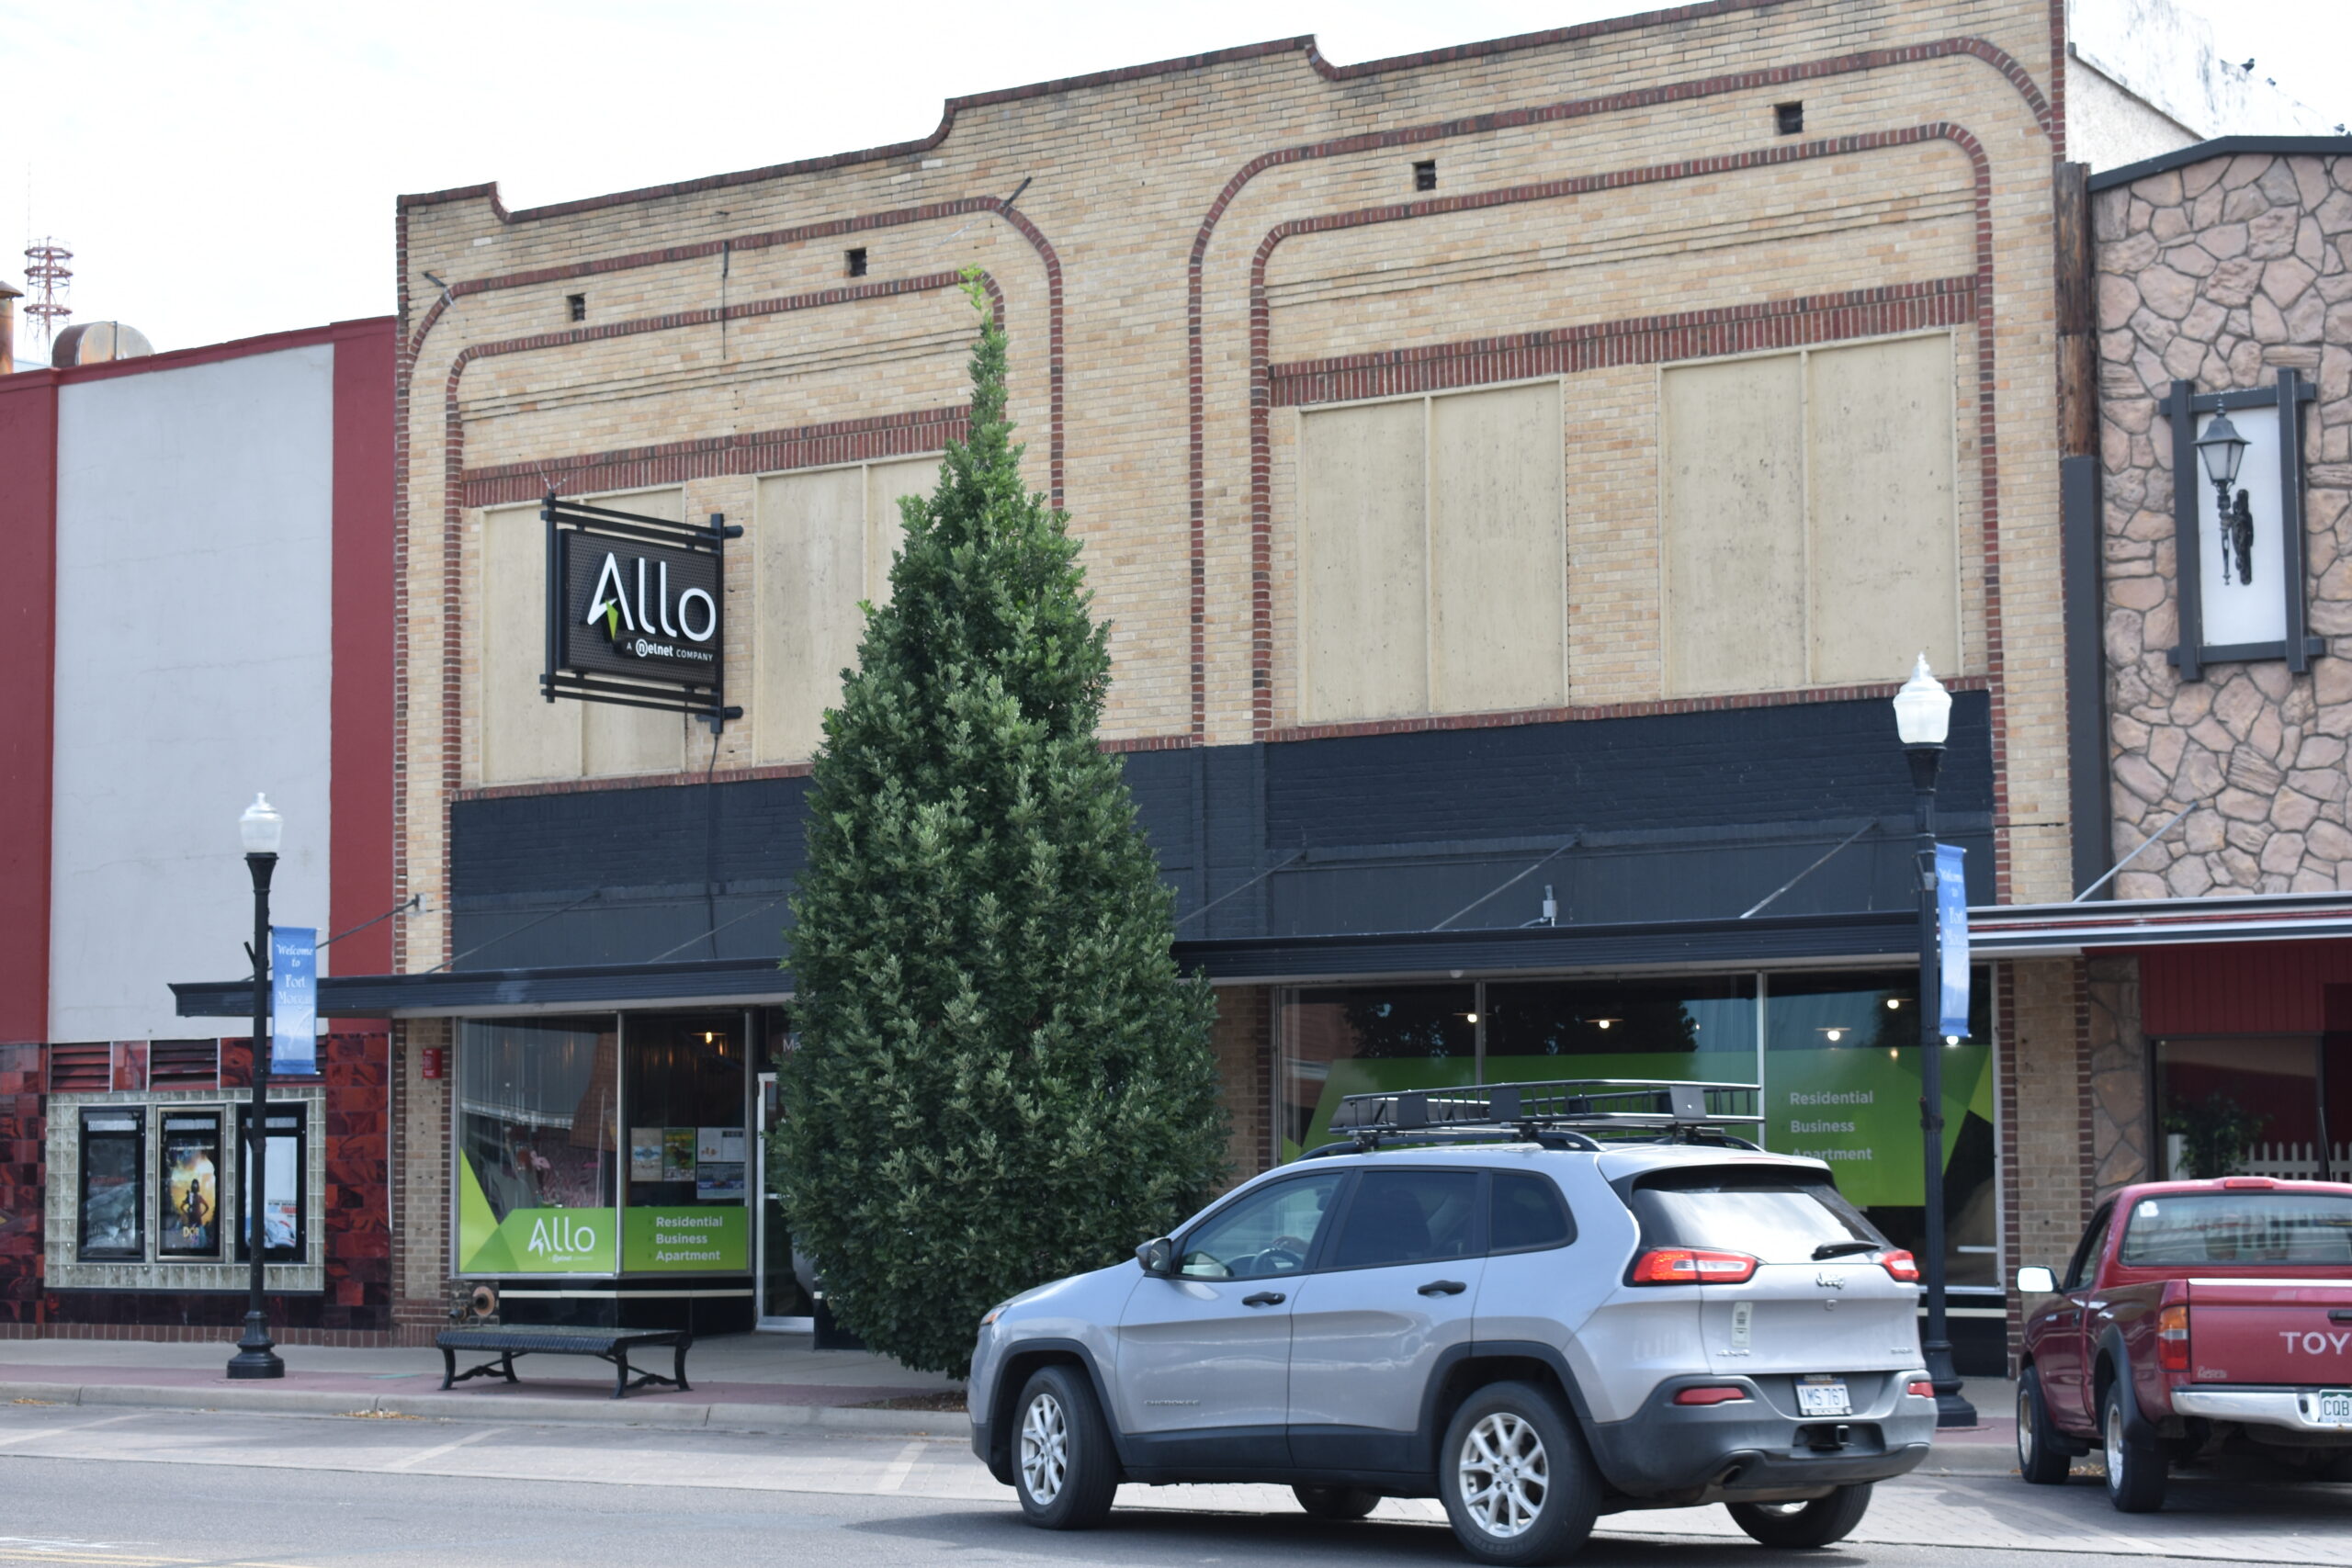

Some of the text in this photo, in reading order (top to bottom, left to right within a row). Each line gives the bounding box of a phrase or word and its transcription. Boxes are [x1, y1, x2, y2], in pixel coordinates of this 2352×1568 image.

[587, 552, 716, 641] Allo
[627, 638, 713, 661] A nelnet COMPANY
[277, 944, 313, 955] Welcome
[292, 958, 300, 967] to
[285, 974, 305, 987] Fort
[1790, 1090, 1874, 1105] Residential
[1791, 1119, 1855, 1133] Business
[656, 1215, 723, 1227] Residential
[527, 1216, 595, 1257] Allo
[656, 1233, 708, 1244] Business
[656, 1250, 721, 1263] Apartment
[2278, 1331, 2352, 1355] TOY
[2324, 1400, 2349, 1416] CQB
